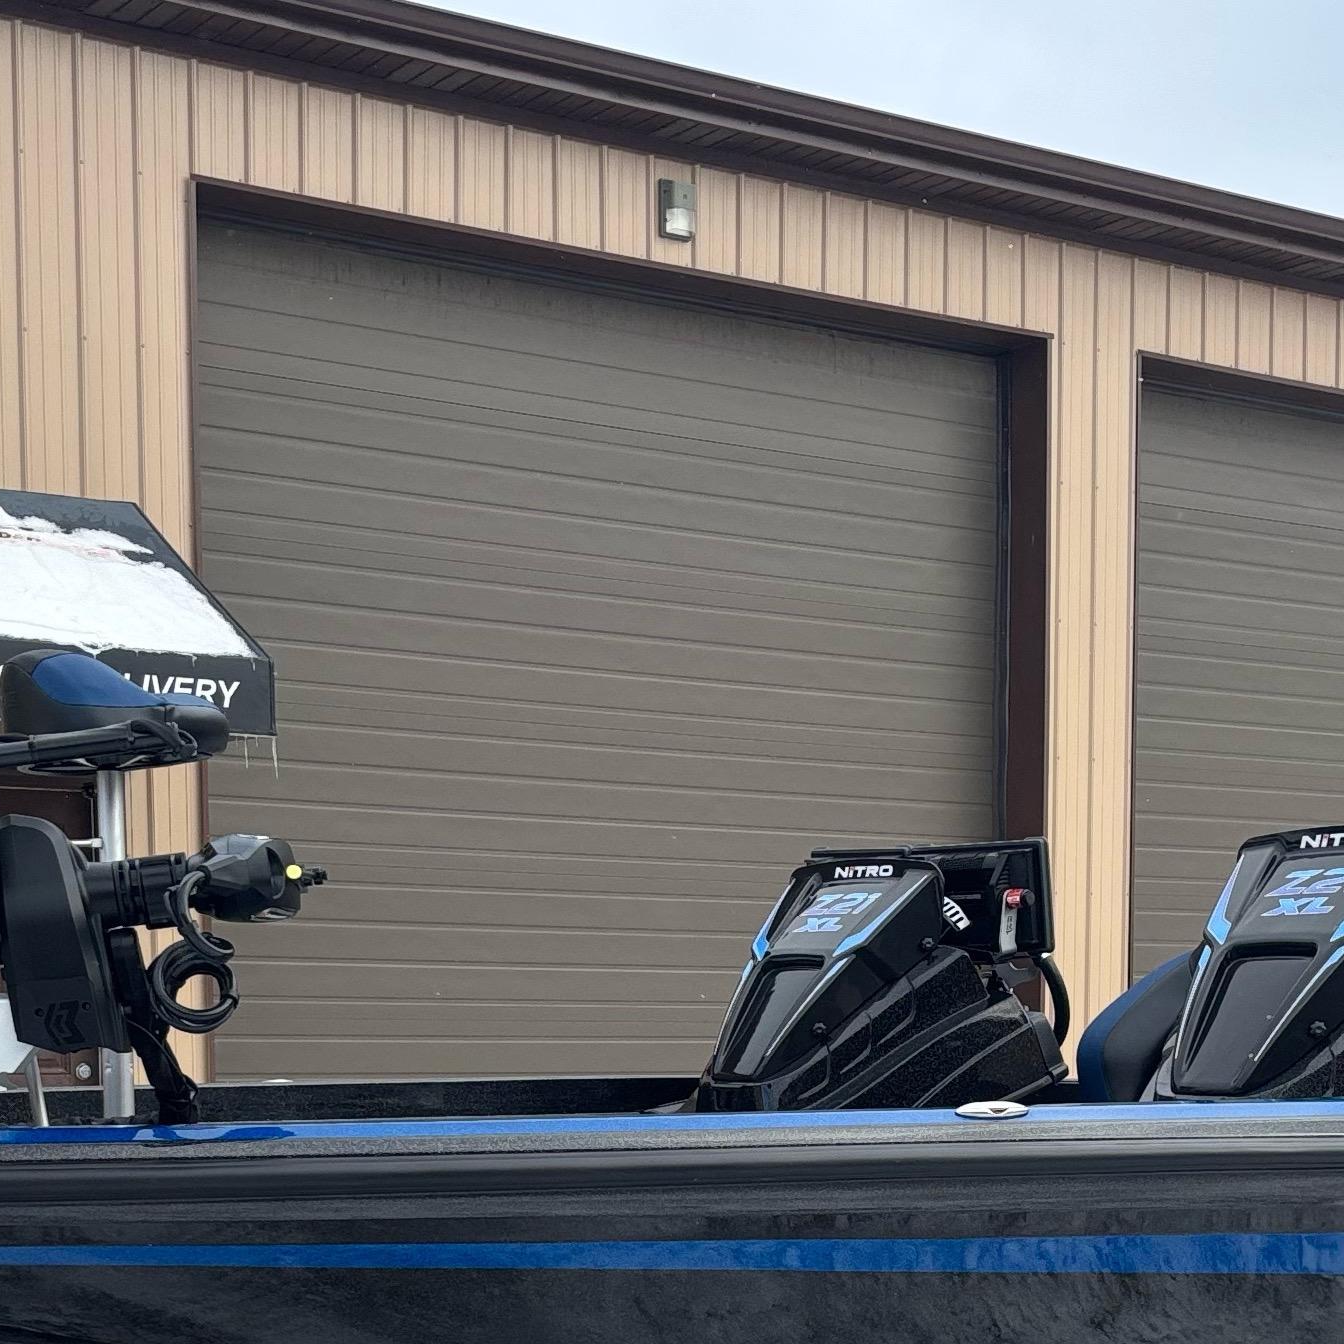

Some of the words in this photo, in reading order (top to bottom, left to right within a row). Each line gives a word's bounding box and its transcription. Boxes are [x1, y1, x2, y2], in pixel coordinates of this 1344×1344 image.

[124, 672, 241, 709] IVERY
[799, 892, 883, 917] Z21
[1260, 896, 1336, 917] XL
[792, 916, 844, 934] XL
